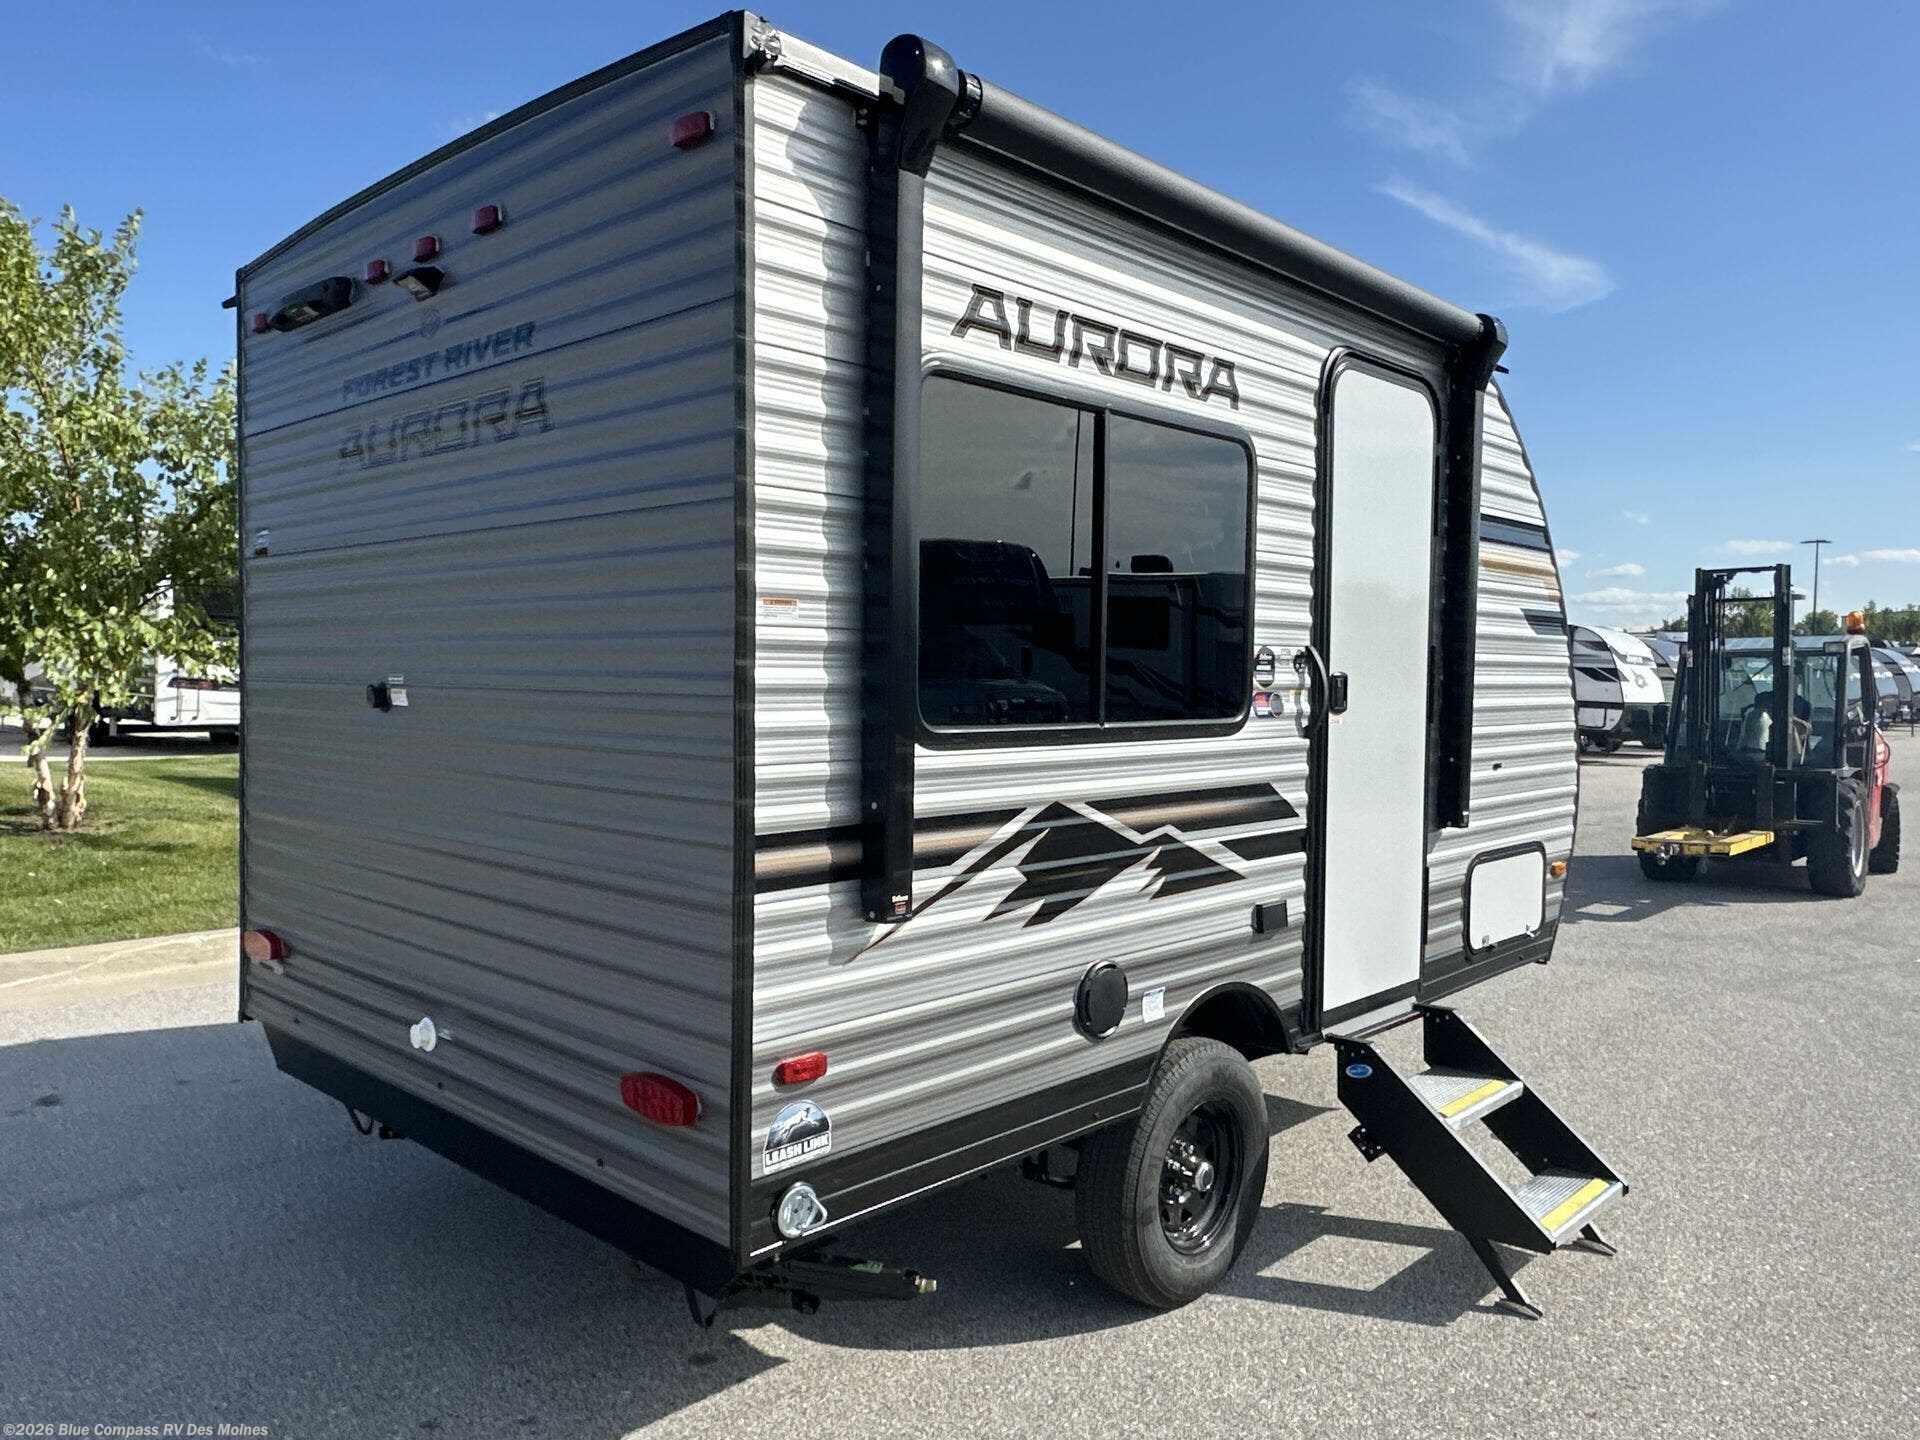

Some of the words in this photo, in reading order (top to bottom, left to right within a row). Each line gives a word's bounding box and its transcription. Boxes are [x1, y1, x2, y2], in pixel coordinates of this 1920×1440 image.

[342, 350, 440, 400] FOREST
[444, 320, 536, 370] RIVER
[951, 284, 1239, 410] AURORA
[336, 376, 555, 475] AURORA
[765, 1143, 803, 1166] LEASH
[804, 1134, 829, 1152] LINK
